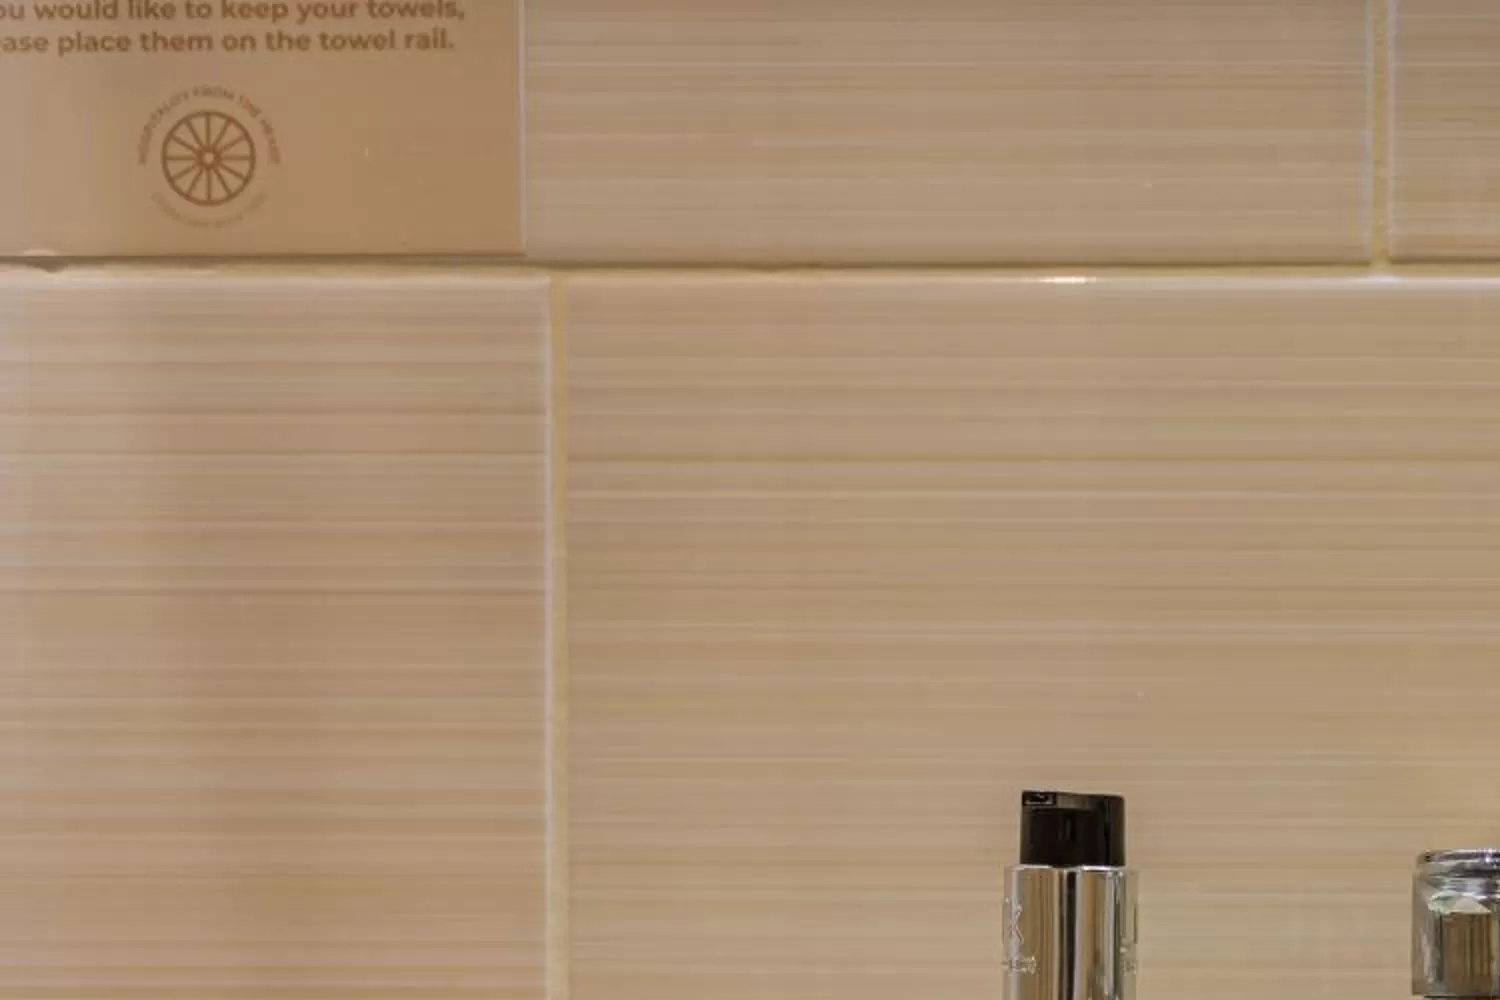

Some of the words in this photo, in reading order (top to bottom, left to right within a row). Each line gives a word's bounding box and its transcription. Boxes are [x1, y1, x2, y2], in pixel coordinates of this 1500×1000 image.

[33, 0, 118, 20] would
[128, 0, 176, 20] like
[185, 0, 213, 20] to
[221, 0, 289, 24] keep
[297, 2, 356, 25] your
[368, 0, 465, 21] towels,
[57, 31, 131, 57] place
[139, 31, 213, 52] them
[222, 34, 257, 52] on
[265, 30, 311, 51] the
[319, 28, 395, 51] towel
[404, 26, 455, 51] rail.
